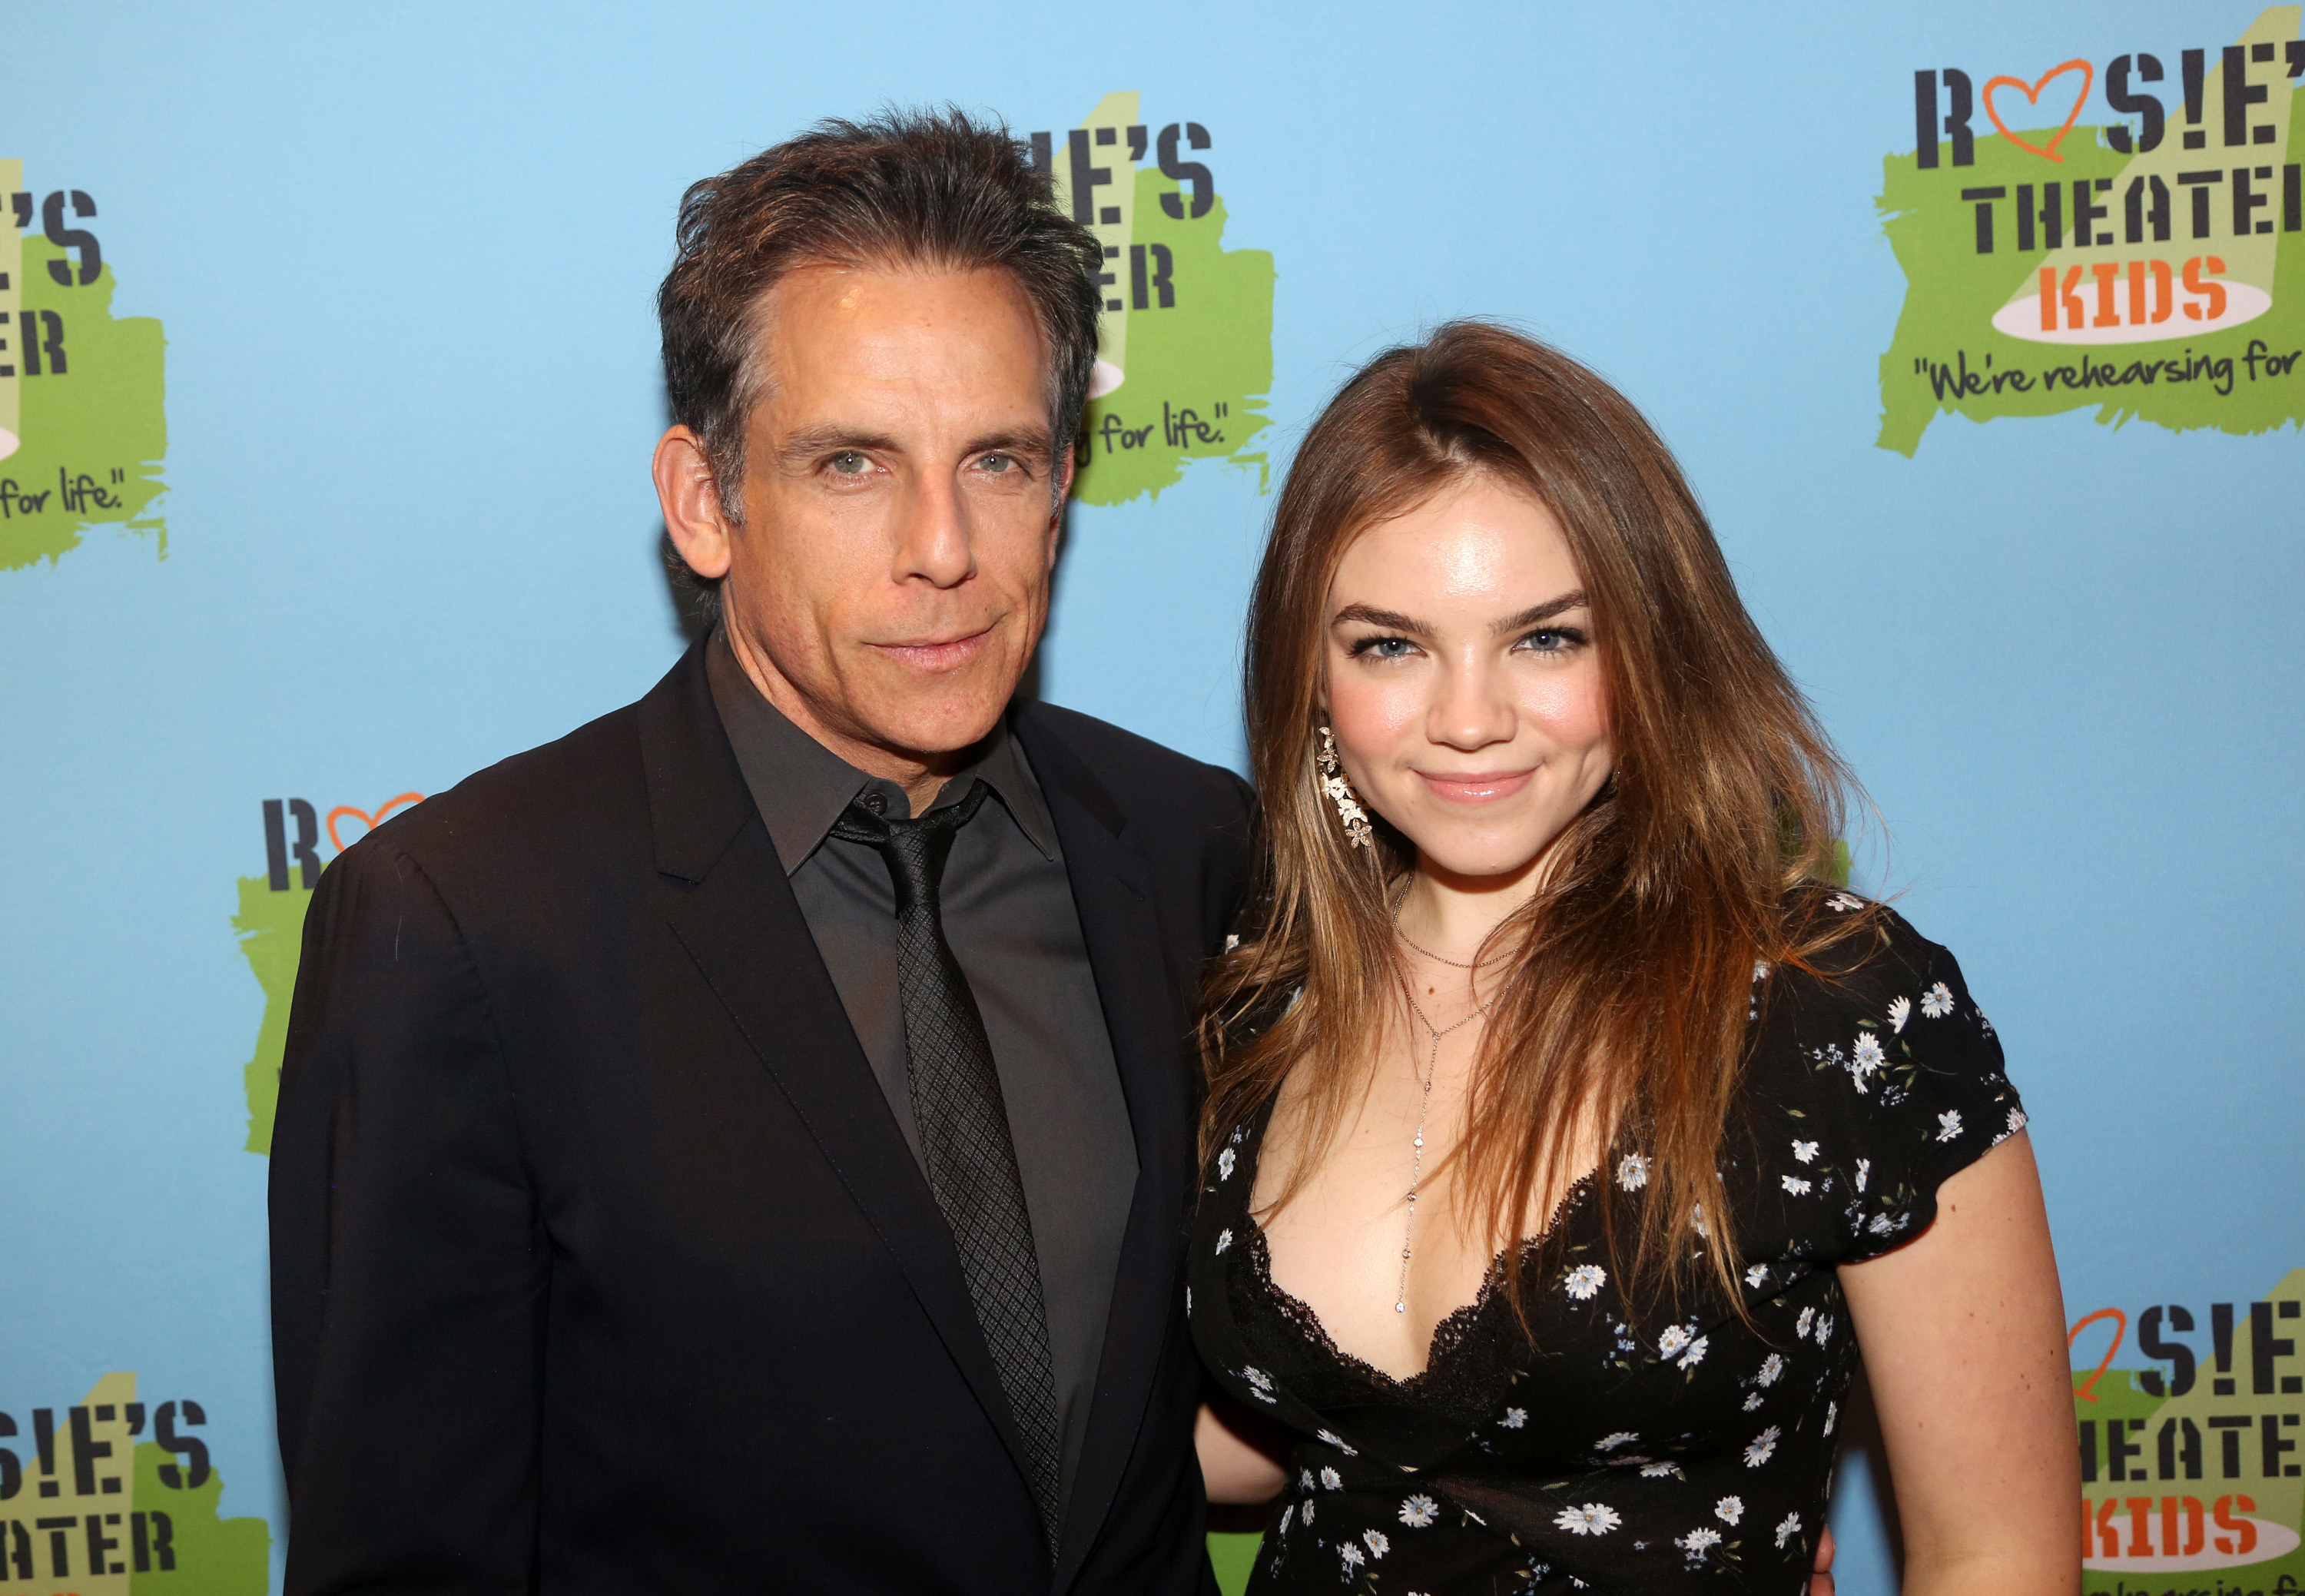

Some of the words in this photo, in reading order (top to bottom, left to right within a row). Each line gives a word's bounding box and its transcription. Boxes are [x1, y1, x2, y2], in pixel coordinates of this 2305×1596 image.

[2038, 255, 2227, 332] KIDS
[2044, 349, 2234, 396] rehearsing
[2243, 340, 2303, 381] for
[1099, 413, 1154, 454] for
[0, 478, 51, 519] for
[2082, 1494, 2257, 1559] KIDS
